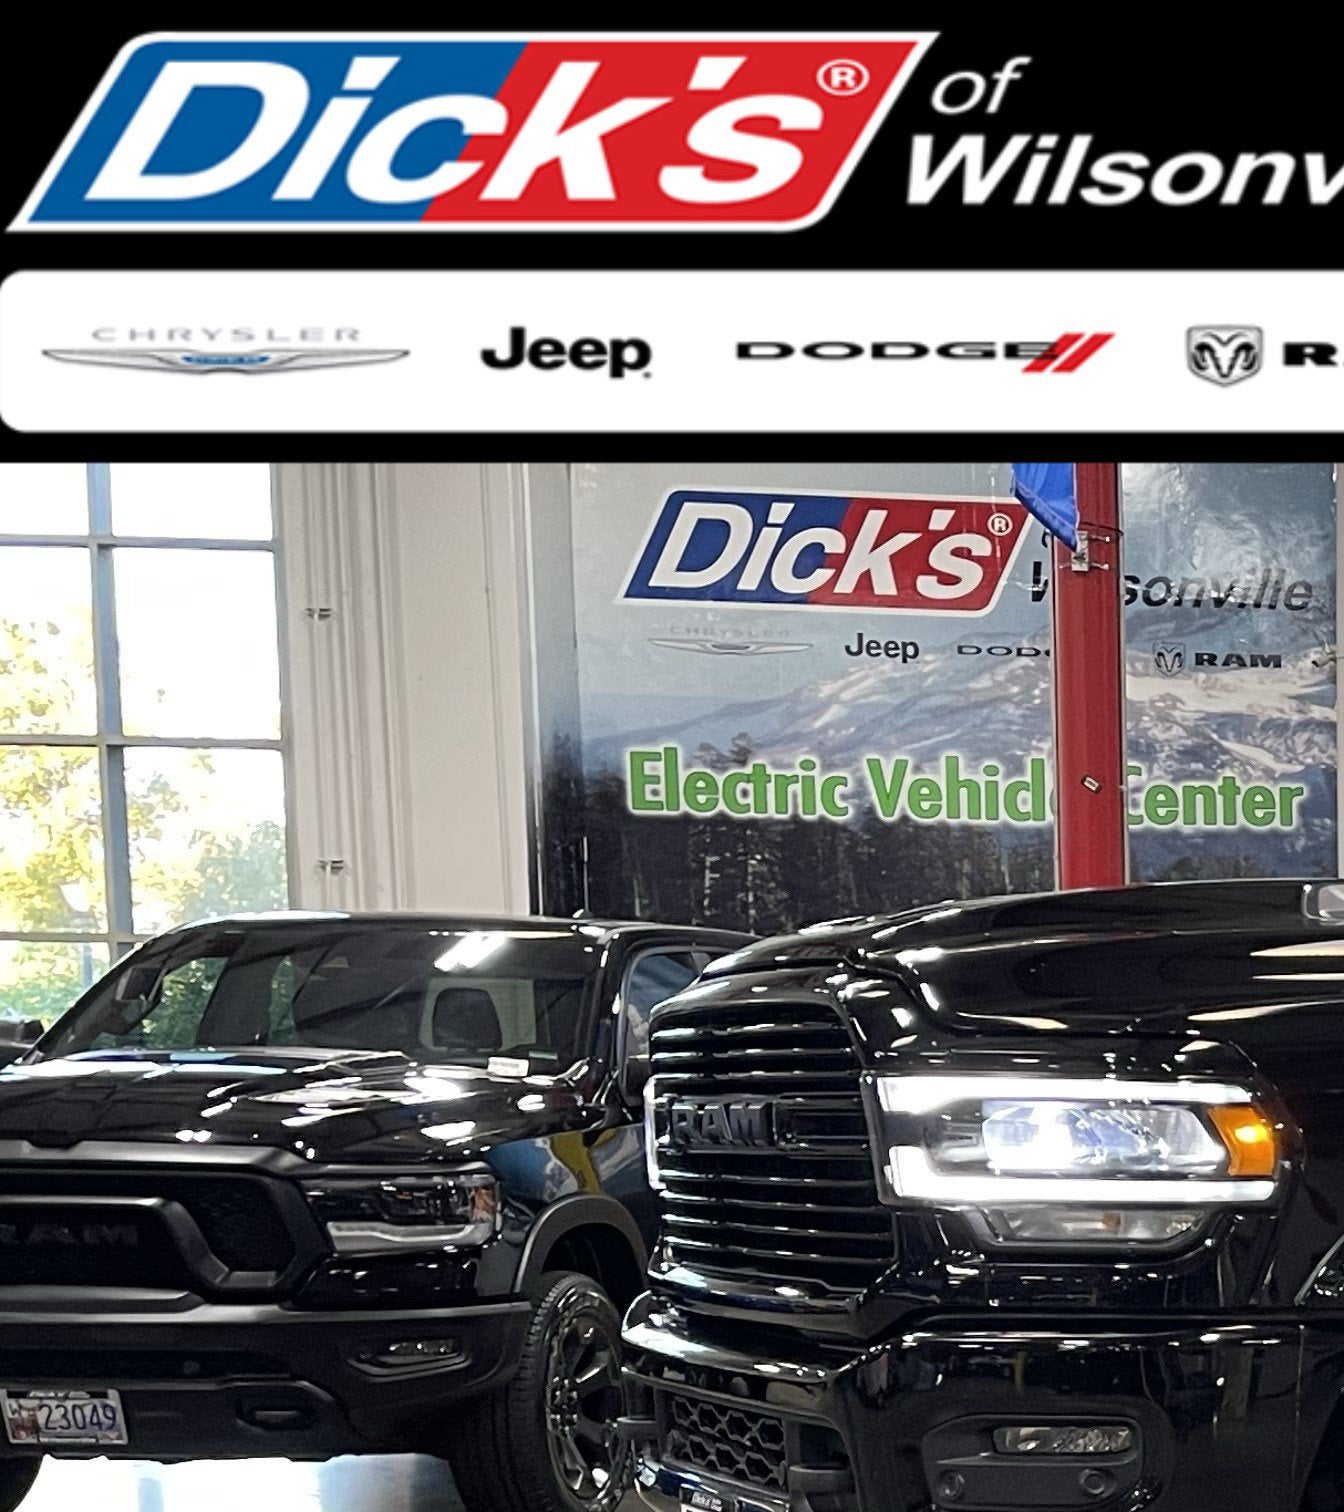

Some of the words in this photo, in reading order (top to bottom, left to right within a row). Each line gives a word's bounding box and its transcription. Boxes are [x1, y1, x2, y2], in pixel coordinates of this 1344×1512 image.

[844, 632, 920, 664] Jeep
[956, 644, 1051, 658] DOD
[1194, 651, 1283, 669] RAM
[628, 746, 849, 818] Electric
[865, 755, 1057, 823] Vehicl
[671, 1102, 765, 1143] RAM
[39, 1403, 117, 1431] 23049
